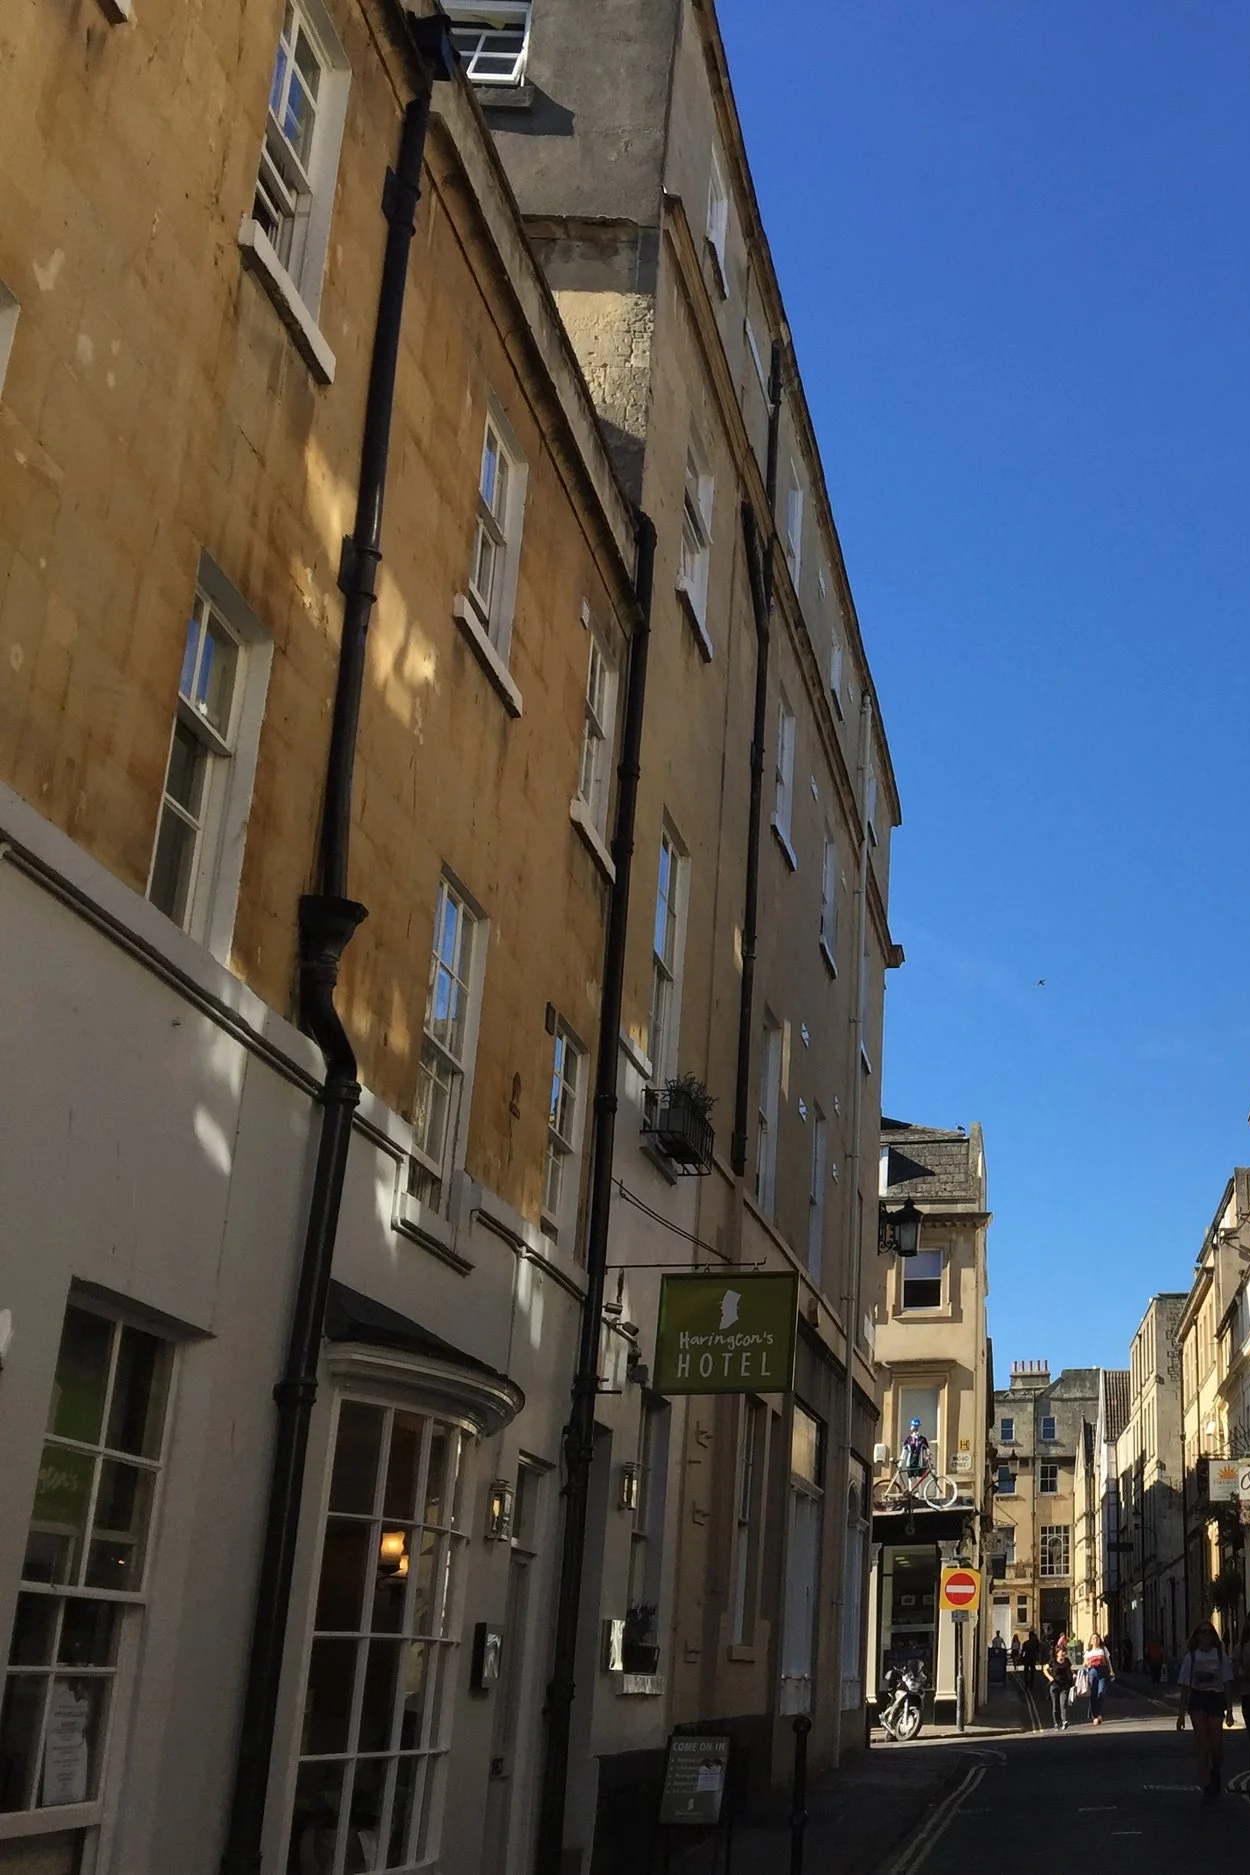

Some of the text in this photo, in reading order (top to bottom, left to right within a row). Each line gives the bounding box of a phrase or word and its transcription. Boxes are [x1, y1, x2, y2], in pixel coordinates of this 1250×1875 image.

[679, 1330, 774, 1350] Harington's
[677, 1351, 771, 1378] HOTEL
[672, 1742, 726, 1752] COME ON IN
